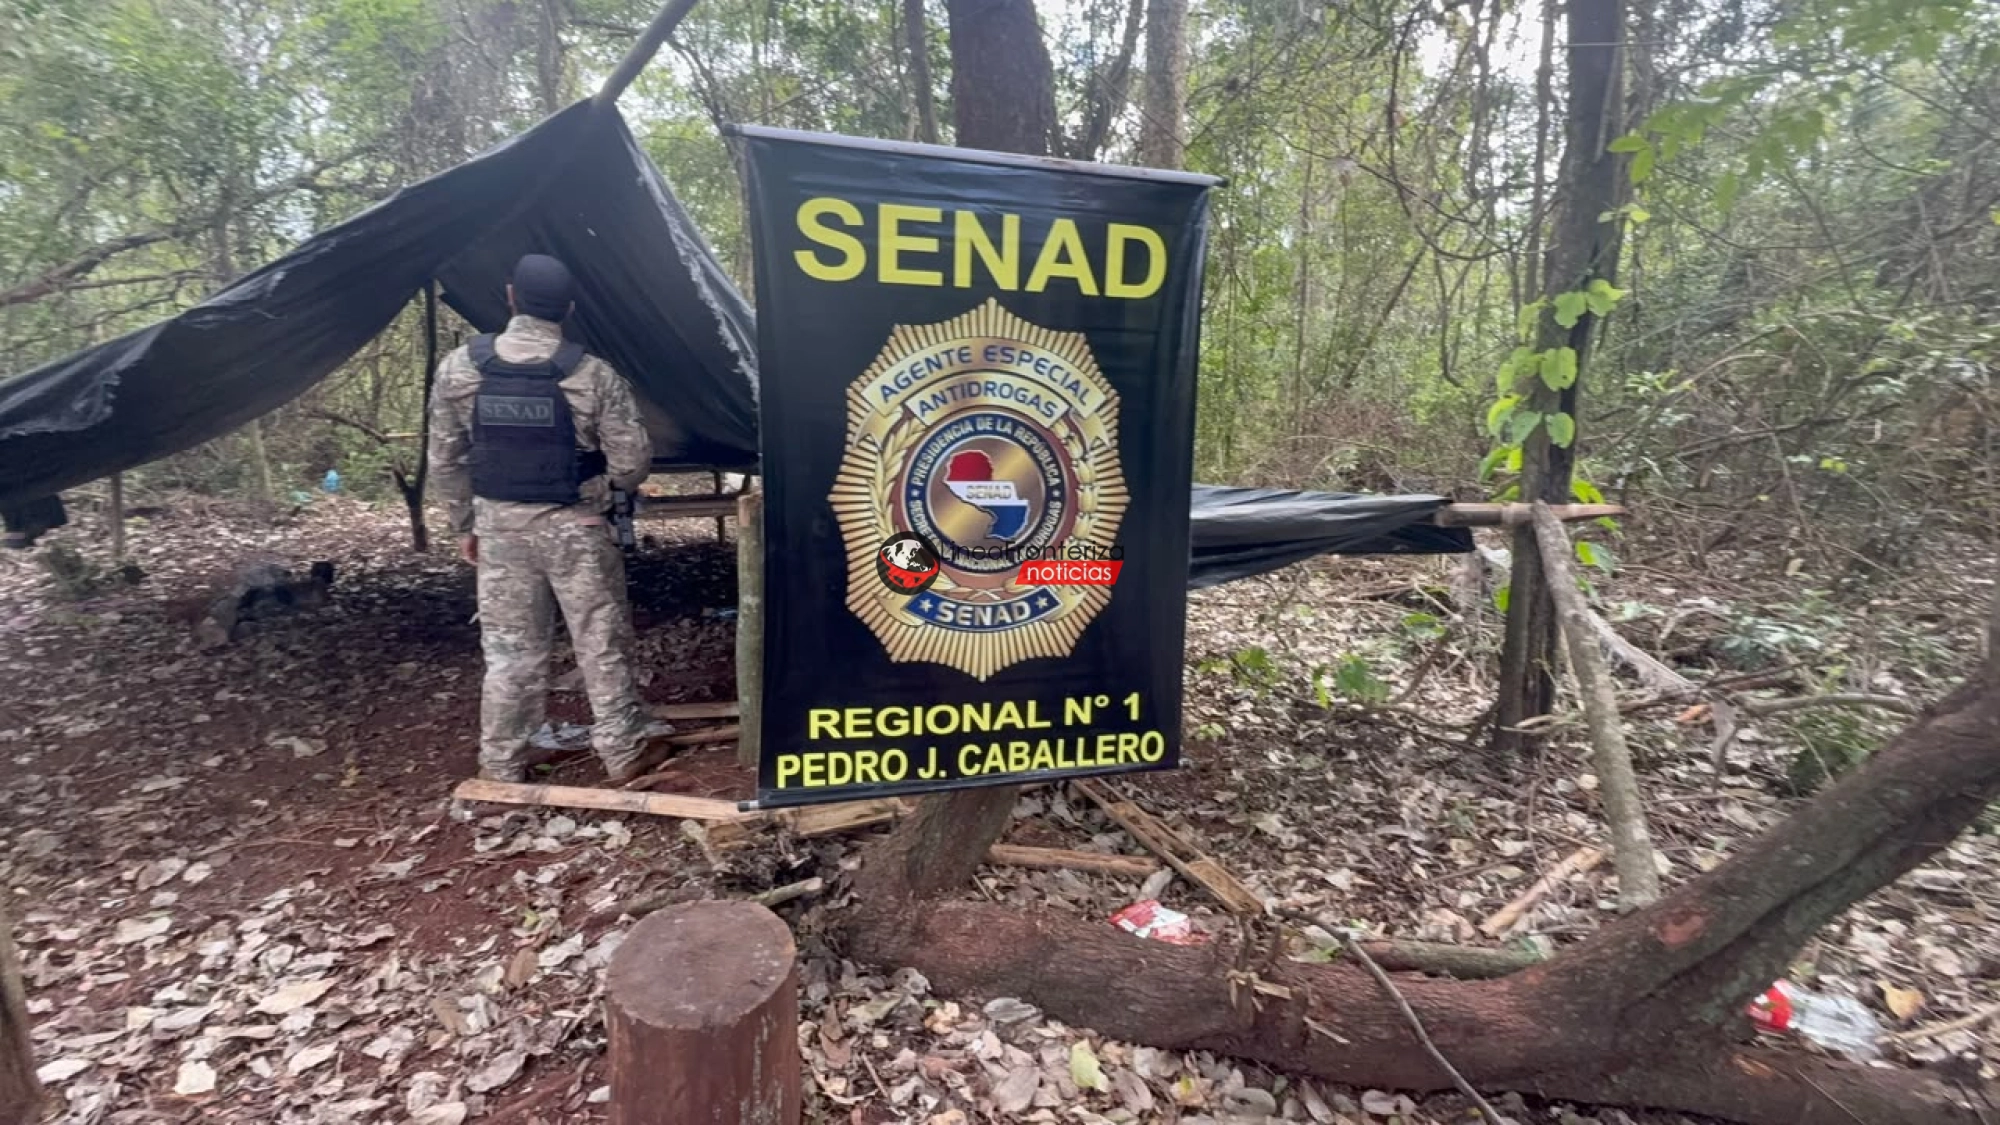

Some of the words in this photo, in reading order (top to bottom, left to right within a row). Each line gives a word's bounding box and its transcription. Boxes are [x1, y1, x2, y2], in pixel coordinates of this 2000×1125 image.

[793, 197, 1168, 299] SENAD
[879, 345, 973, 404] AGENTE
[983, 344, 1092, 406] ESPECIAL
[918, 380, 1057, 419] ANTIDROGAS
[482, 402, 550, 420] SENAD
[910, 421, 975, 487] PRESIDENCIA
[975, 416, 994, 431] DE
[997, 419, 1013, 435] LA
[935, 600, 1031, 626] SENAD
[808, 700, 1051, 740] REGIONAL
[1123, 692, 1140, 721] 1
[776, 747, 907, 789] PEDRO
[917, 747, 947, 780] J.
[957, 730, 1165, 776] CABALLERO
